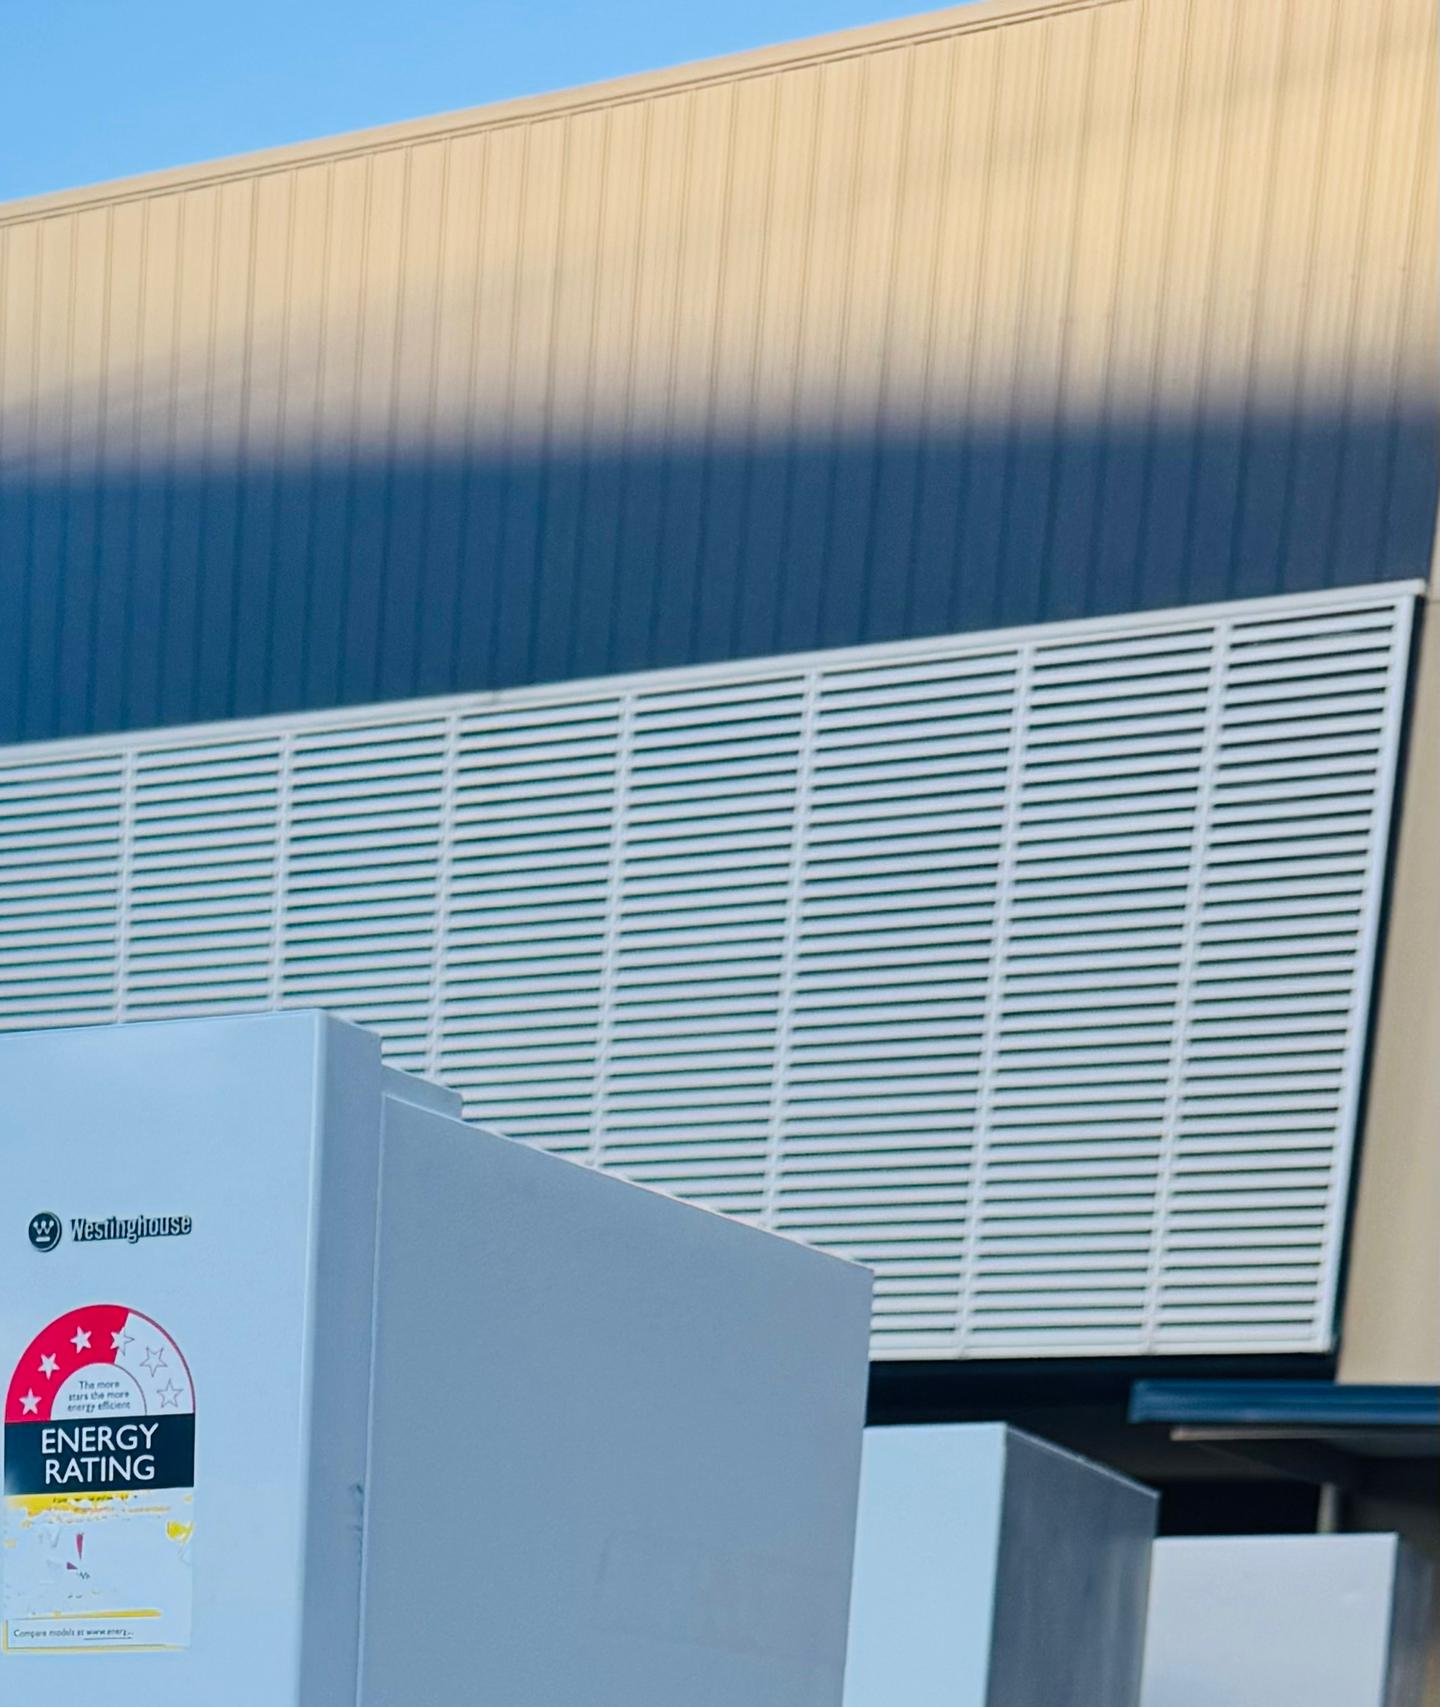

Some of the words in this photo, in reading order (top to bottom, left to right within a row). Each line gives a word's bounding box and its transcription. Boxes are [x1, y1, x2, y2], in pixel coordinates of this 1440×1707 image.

[71, 1214, 192, 1244] Westinghouse
[79, 1381, 95, 1389] The
[91, 1391, 105, 1400] the
[107, 1391, 130, 1399] more
[67, 1404, 95, 1413] energy
[98, 1401, 131, 1410] efficient
[42, 1423, 159, 1454] ENERGY
[45, 1455, 155, 1485] RATING
